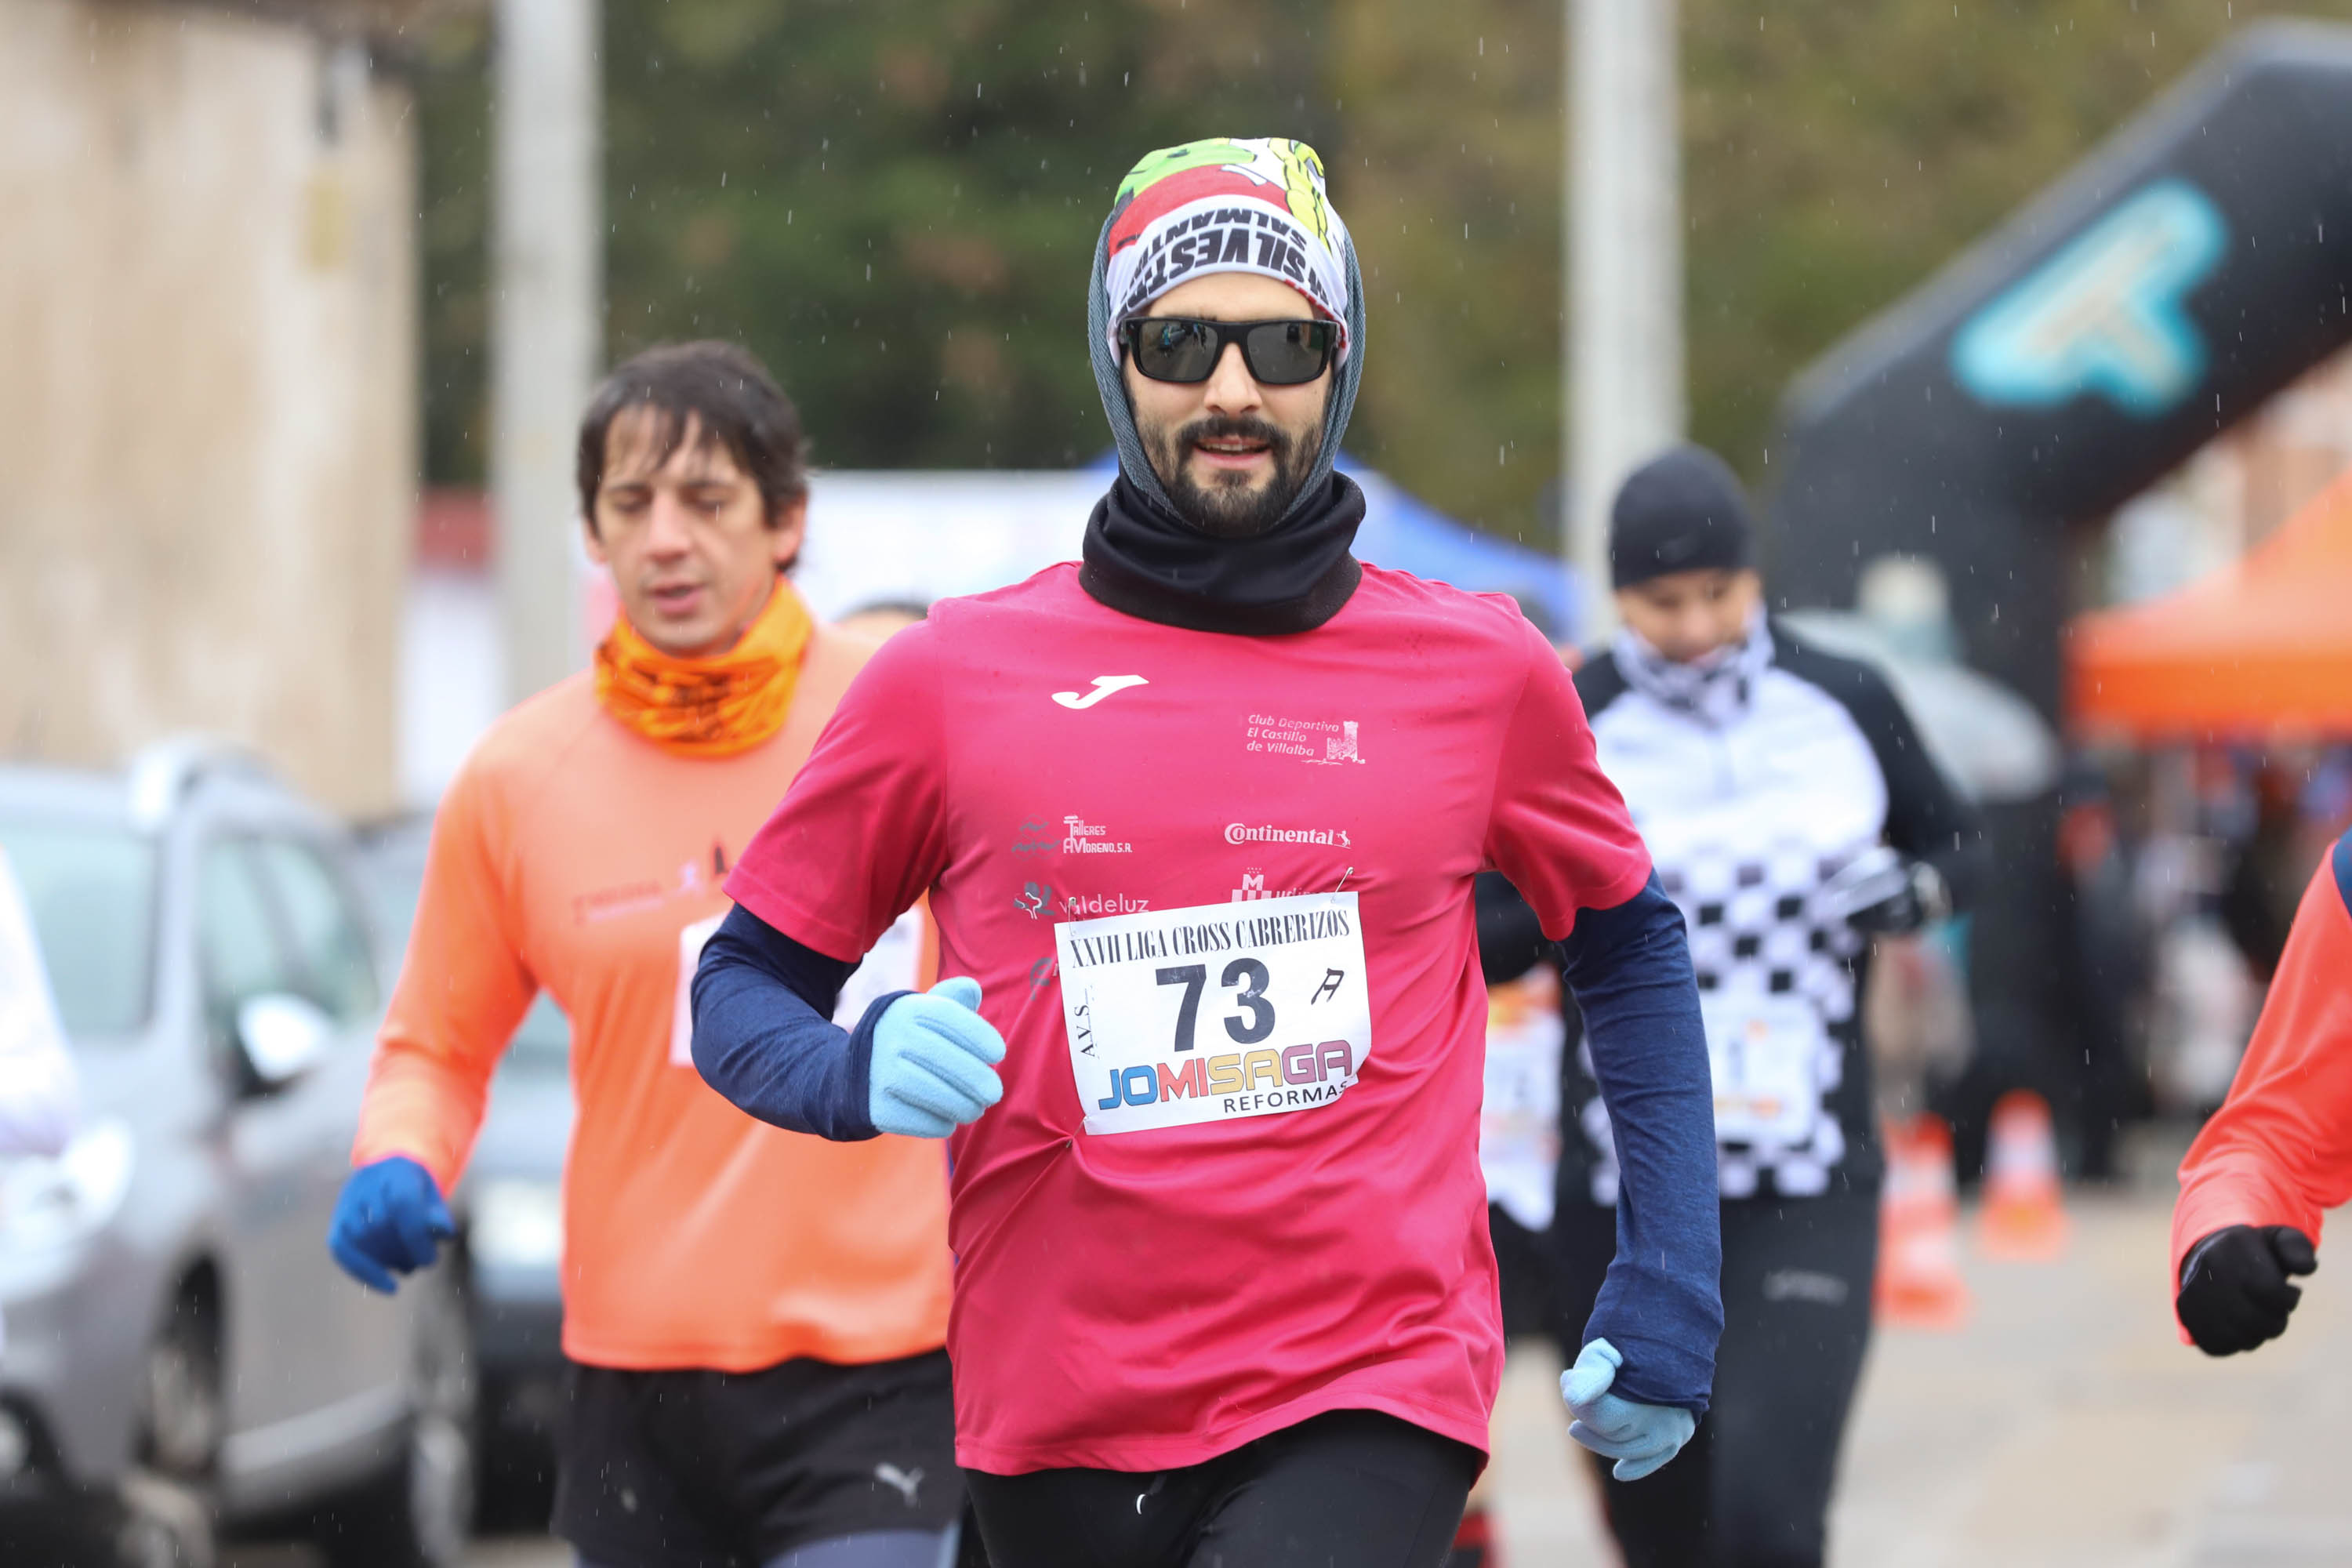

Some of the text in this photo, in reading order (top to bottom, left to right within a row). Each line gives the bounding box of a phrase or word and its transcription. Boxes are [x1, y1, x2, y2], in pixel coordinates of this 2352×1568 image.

[1247, 728, 1307, 742] El Castillo
[1248, 714, 1340, 732] Club Deportivo
[1247, 740, 1315, 757] de Villalba
[1225, 823, 1334, 845] Continental
[1126, 928, 1168, 961] LIGA
[1174, 920, 1231, 956] CROSS
[1235, 909, 1350, 949] CABRERIZOS
[1155, 957, 1276, 1053] 73
[1098, 1039, 1353, 1111] JOMISAGA
[1223, 1080, 1348, 1114] REFORMAS
